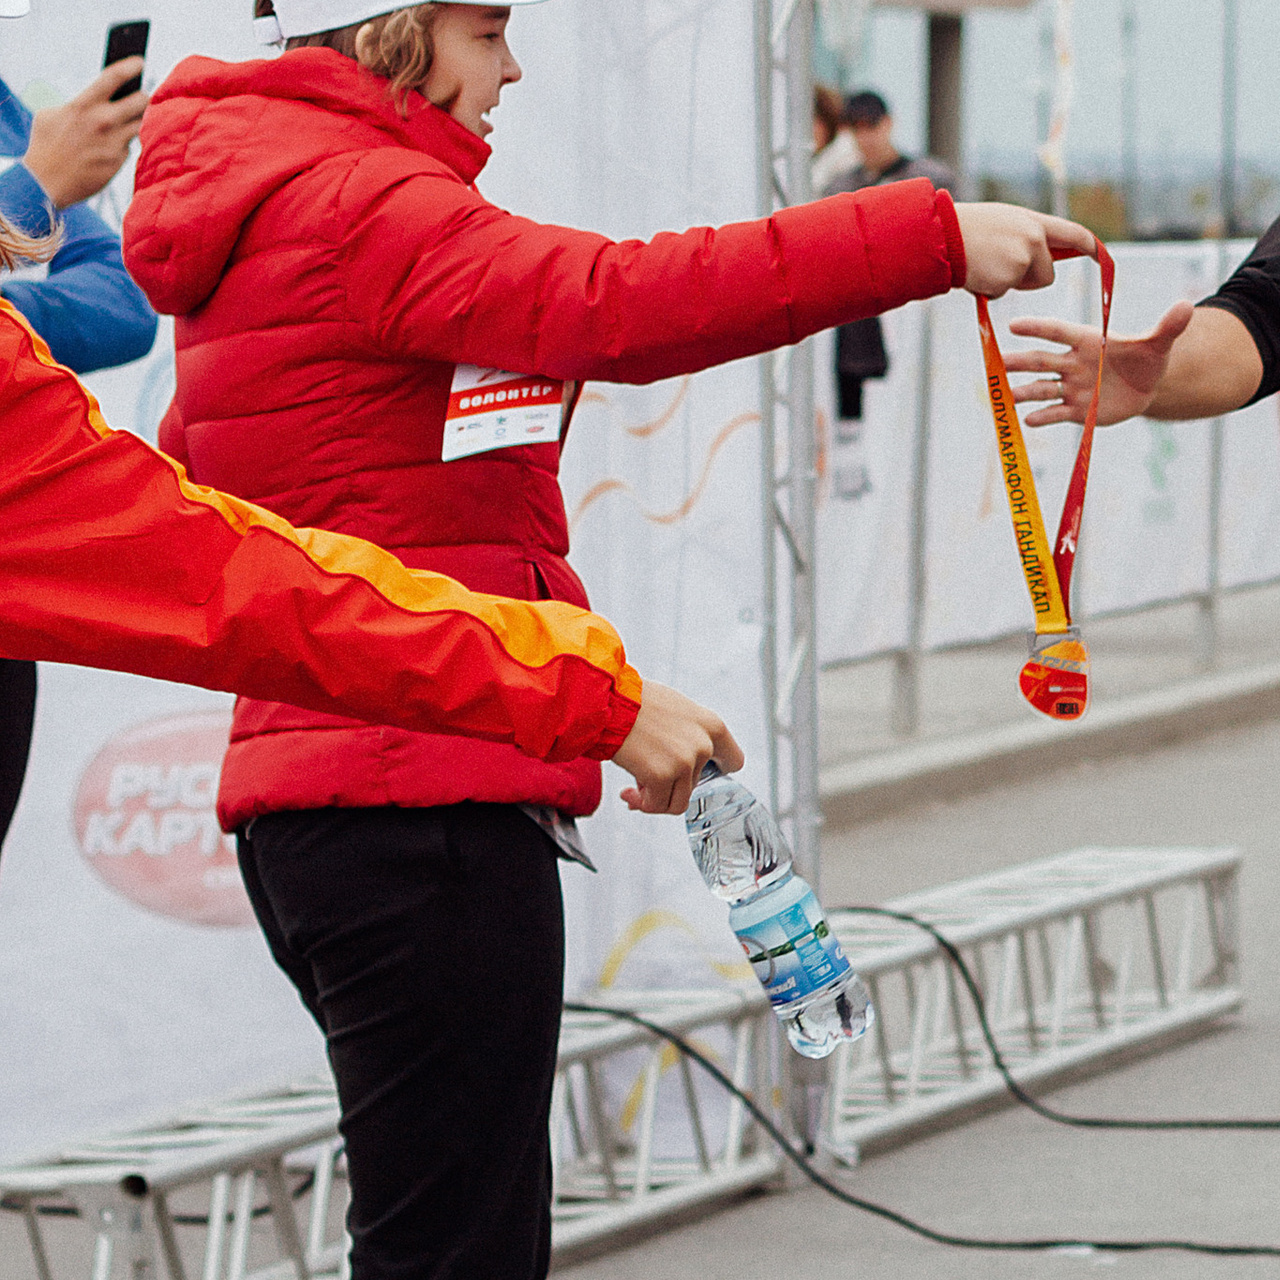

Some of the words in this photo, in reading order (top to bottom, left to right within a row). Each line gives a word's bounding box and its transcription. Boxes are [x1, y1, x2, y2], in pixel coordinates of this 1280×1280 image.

[988, 375, 1028, 515] ПОЛУМАРАФОН
[1014, 521, 1051, 613] ГАНДИКАП
[83, 811, 237, 856] КАРТ
